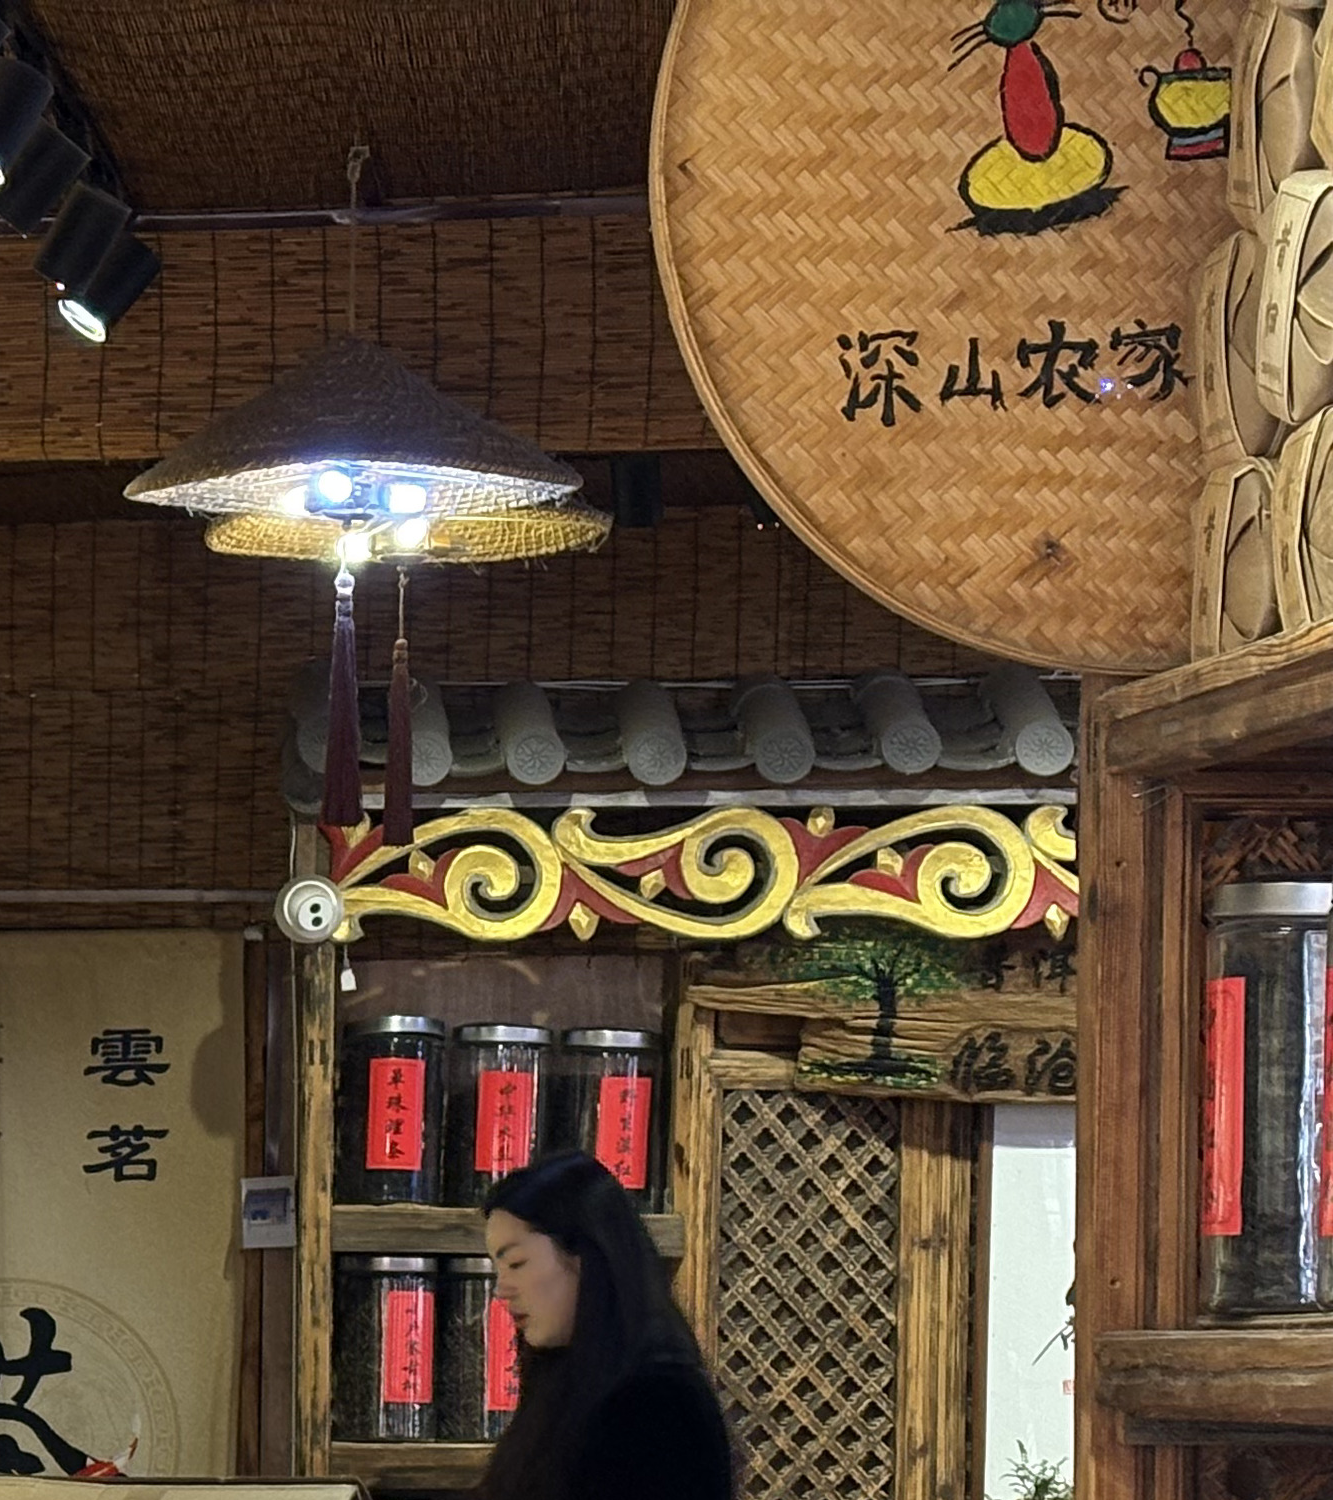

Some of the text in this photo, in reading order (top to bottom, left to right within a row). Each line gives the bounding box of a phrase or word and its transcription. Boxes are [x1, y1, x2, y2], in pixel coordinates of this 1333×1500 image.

[836, 318, 1195, 427] 深山农家
[83, 1028, 171, 1182] 雲茗
